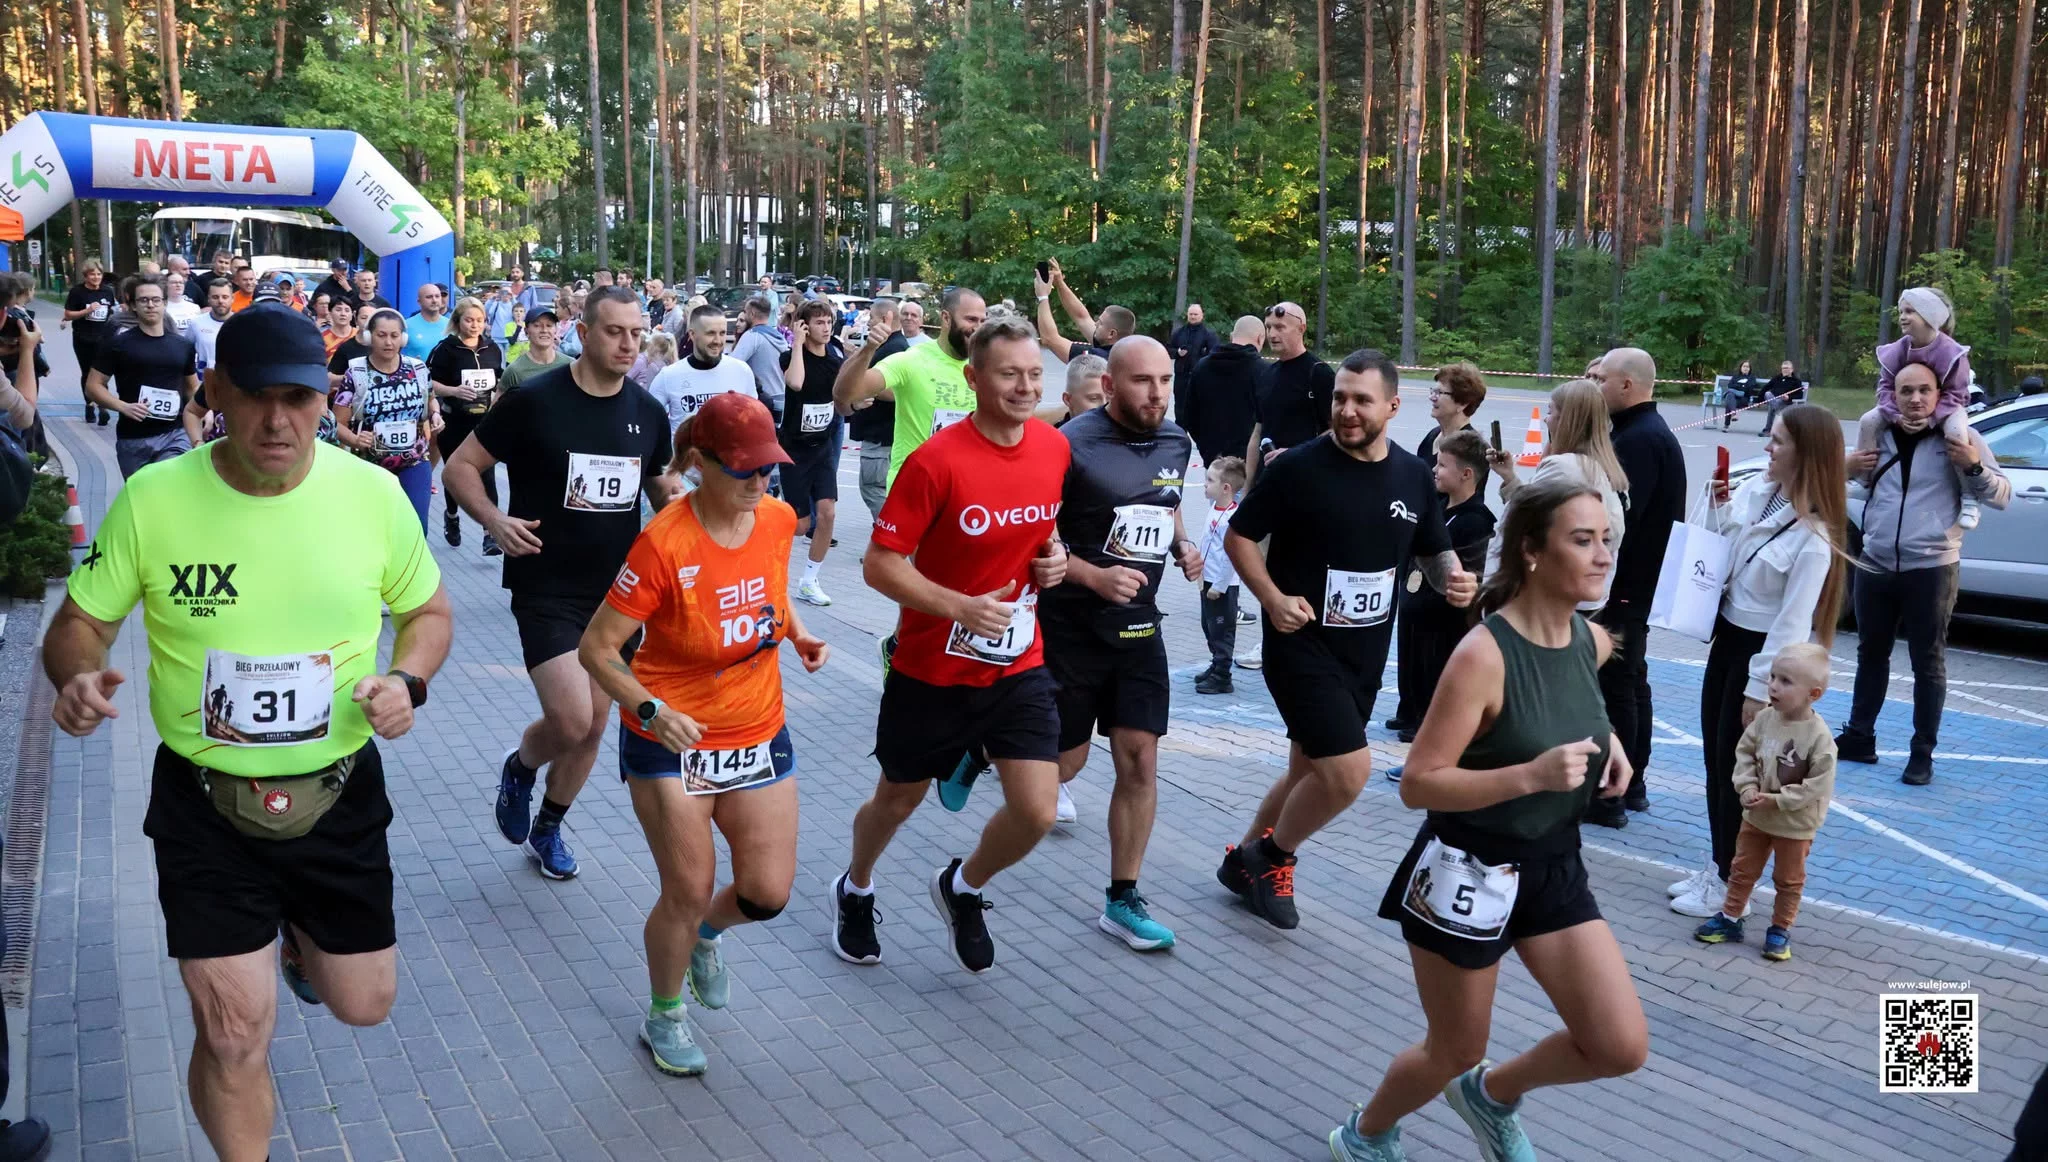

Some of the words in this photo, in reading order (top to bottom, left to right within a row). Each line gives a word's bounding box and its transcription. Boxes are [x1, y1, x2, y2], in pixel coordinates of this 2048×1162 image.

[134, 138, 277, 183] META
[473, 379, 488, 388] 55
[154, 399, 172, 412] 29
[814, 413, 830, 425] 172
[391, 432, 408, 444] 88
[597, 477, 621, 498] 19
[1135, 526, 1160, 548] 111
[168, 563, 239, 597] XIX
[715, 576, 766, 610] ale
[1354, 592, 1382, 613] 30
[190, 607, 217, 617] 2024
[720, 614, 773, 648] 10K
[235, 660, 252, 672] BIEG
[254, 661, 301, 672] PRZEŁAJOWY
[252, 689, 296, 723] 31
[709, 744, 758, 775] 145
[1451, 883, 1477, 916] 5
